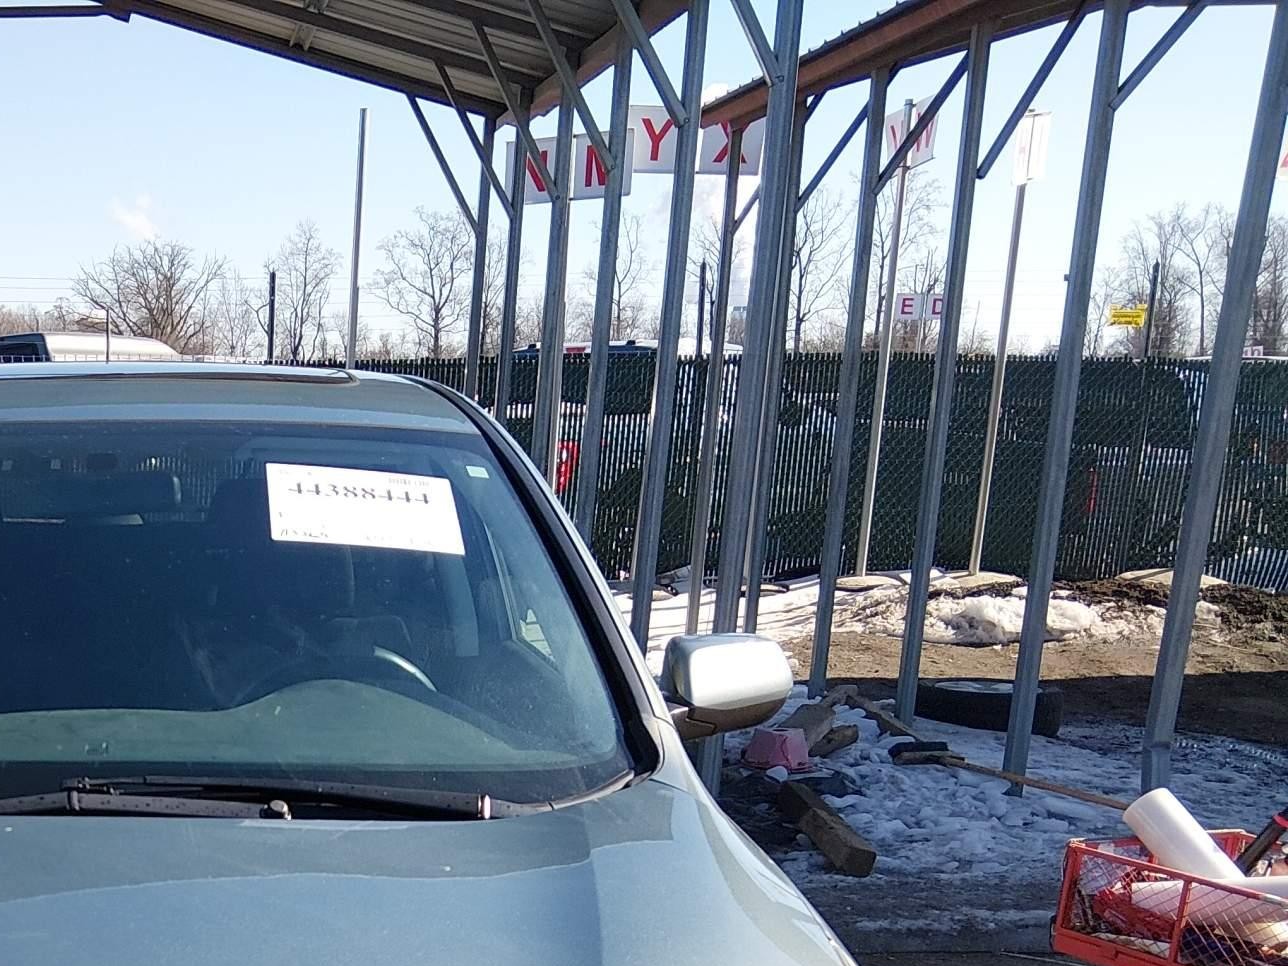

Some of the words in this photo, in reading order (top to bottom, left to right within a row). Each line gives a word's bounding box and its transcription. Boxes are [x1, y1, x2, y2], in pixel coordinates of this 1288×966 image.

[641, 117, 675, 161] Y
[901, 297, 915, 315] E
[288, 482, 429, 505] 44388444
